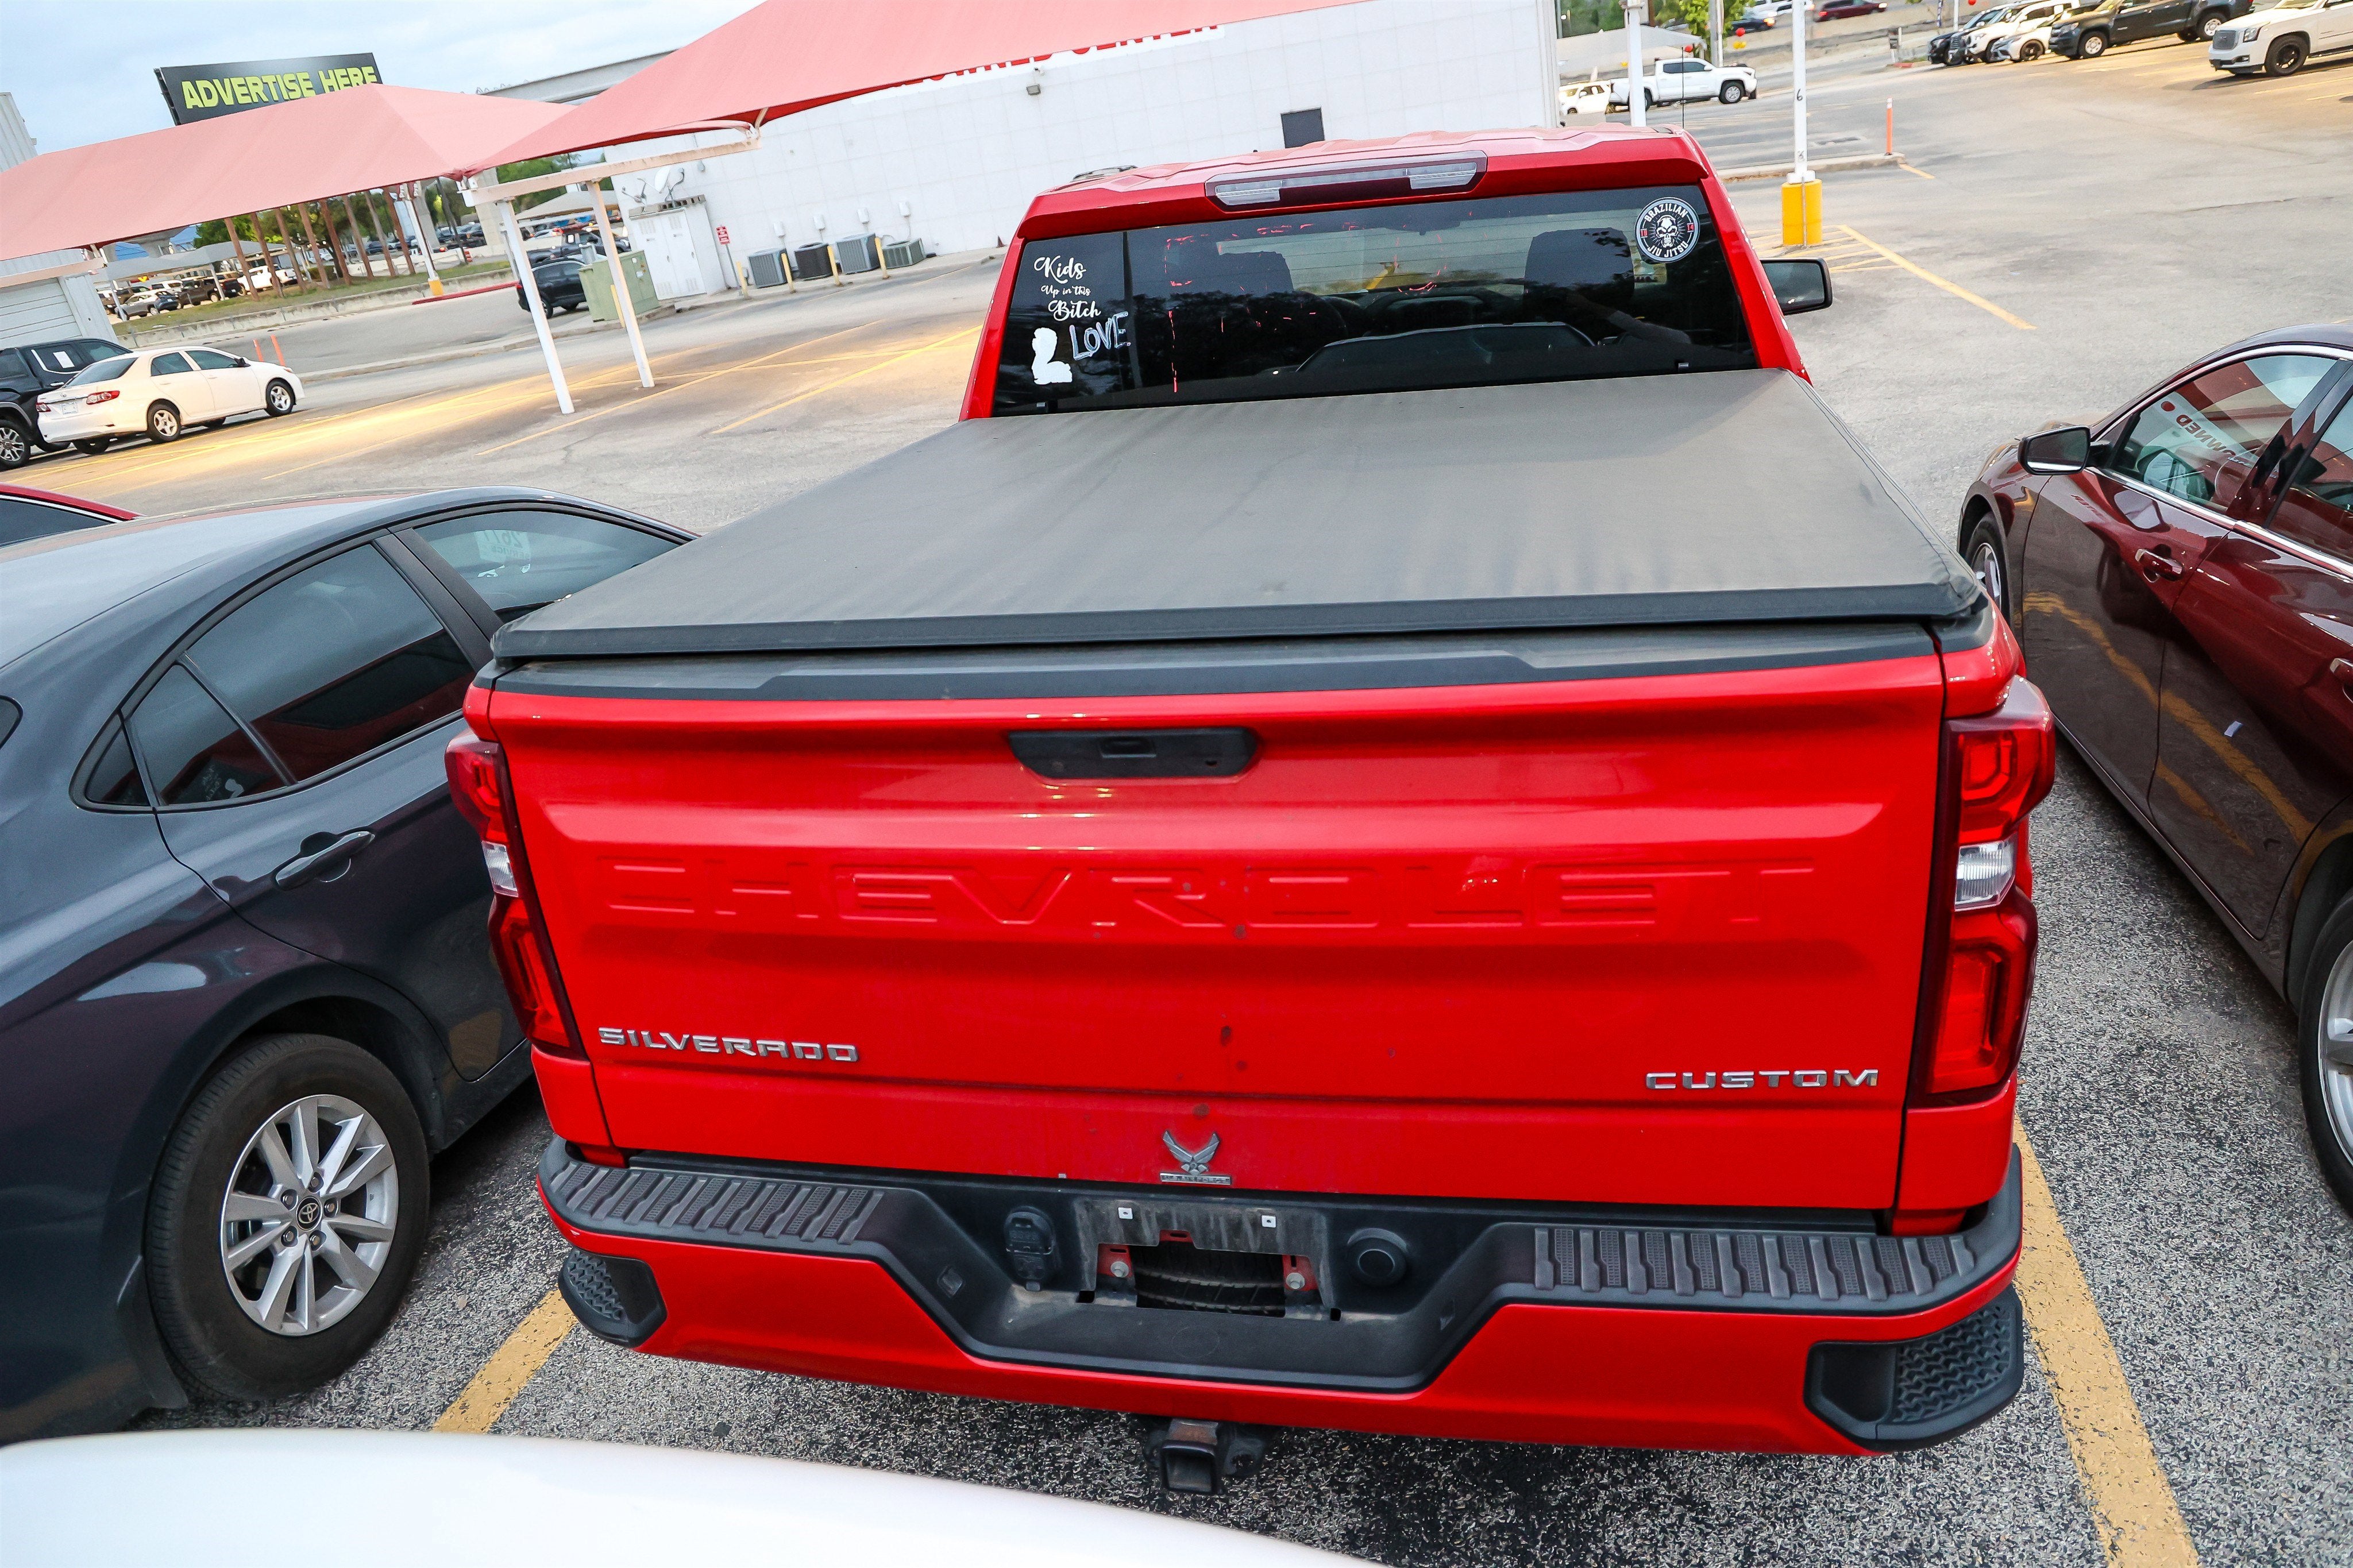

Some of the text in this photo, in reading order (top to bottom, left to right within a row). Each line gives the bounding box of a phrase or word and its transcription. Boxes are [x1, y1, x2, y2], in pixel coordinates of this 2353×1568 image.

[181, 66, 377, 109] ADVERTISE HERE
[1796, 88, 1803, 101] 6
[1644, 203, 1688, 222] BRAZILIAN
[1647, 241, 1689, 258] JIU JITSU
[1033, 255, 1087, 284] Kids
[1040, 284, 1060, 298] Up
[1071, 285, 1091, 296] this
[1048, 300, 1101, 321] Bitch
[1069, 311, 1132, 361] LOVE
[596, 855, 1814, 928] CHEVROLET
[598, 1027, 859, 1063] SILVERADO
[1646, 1069, 1879, 1090] CUSTOM
